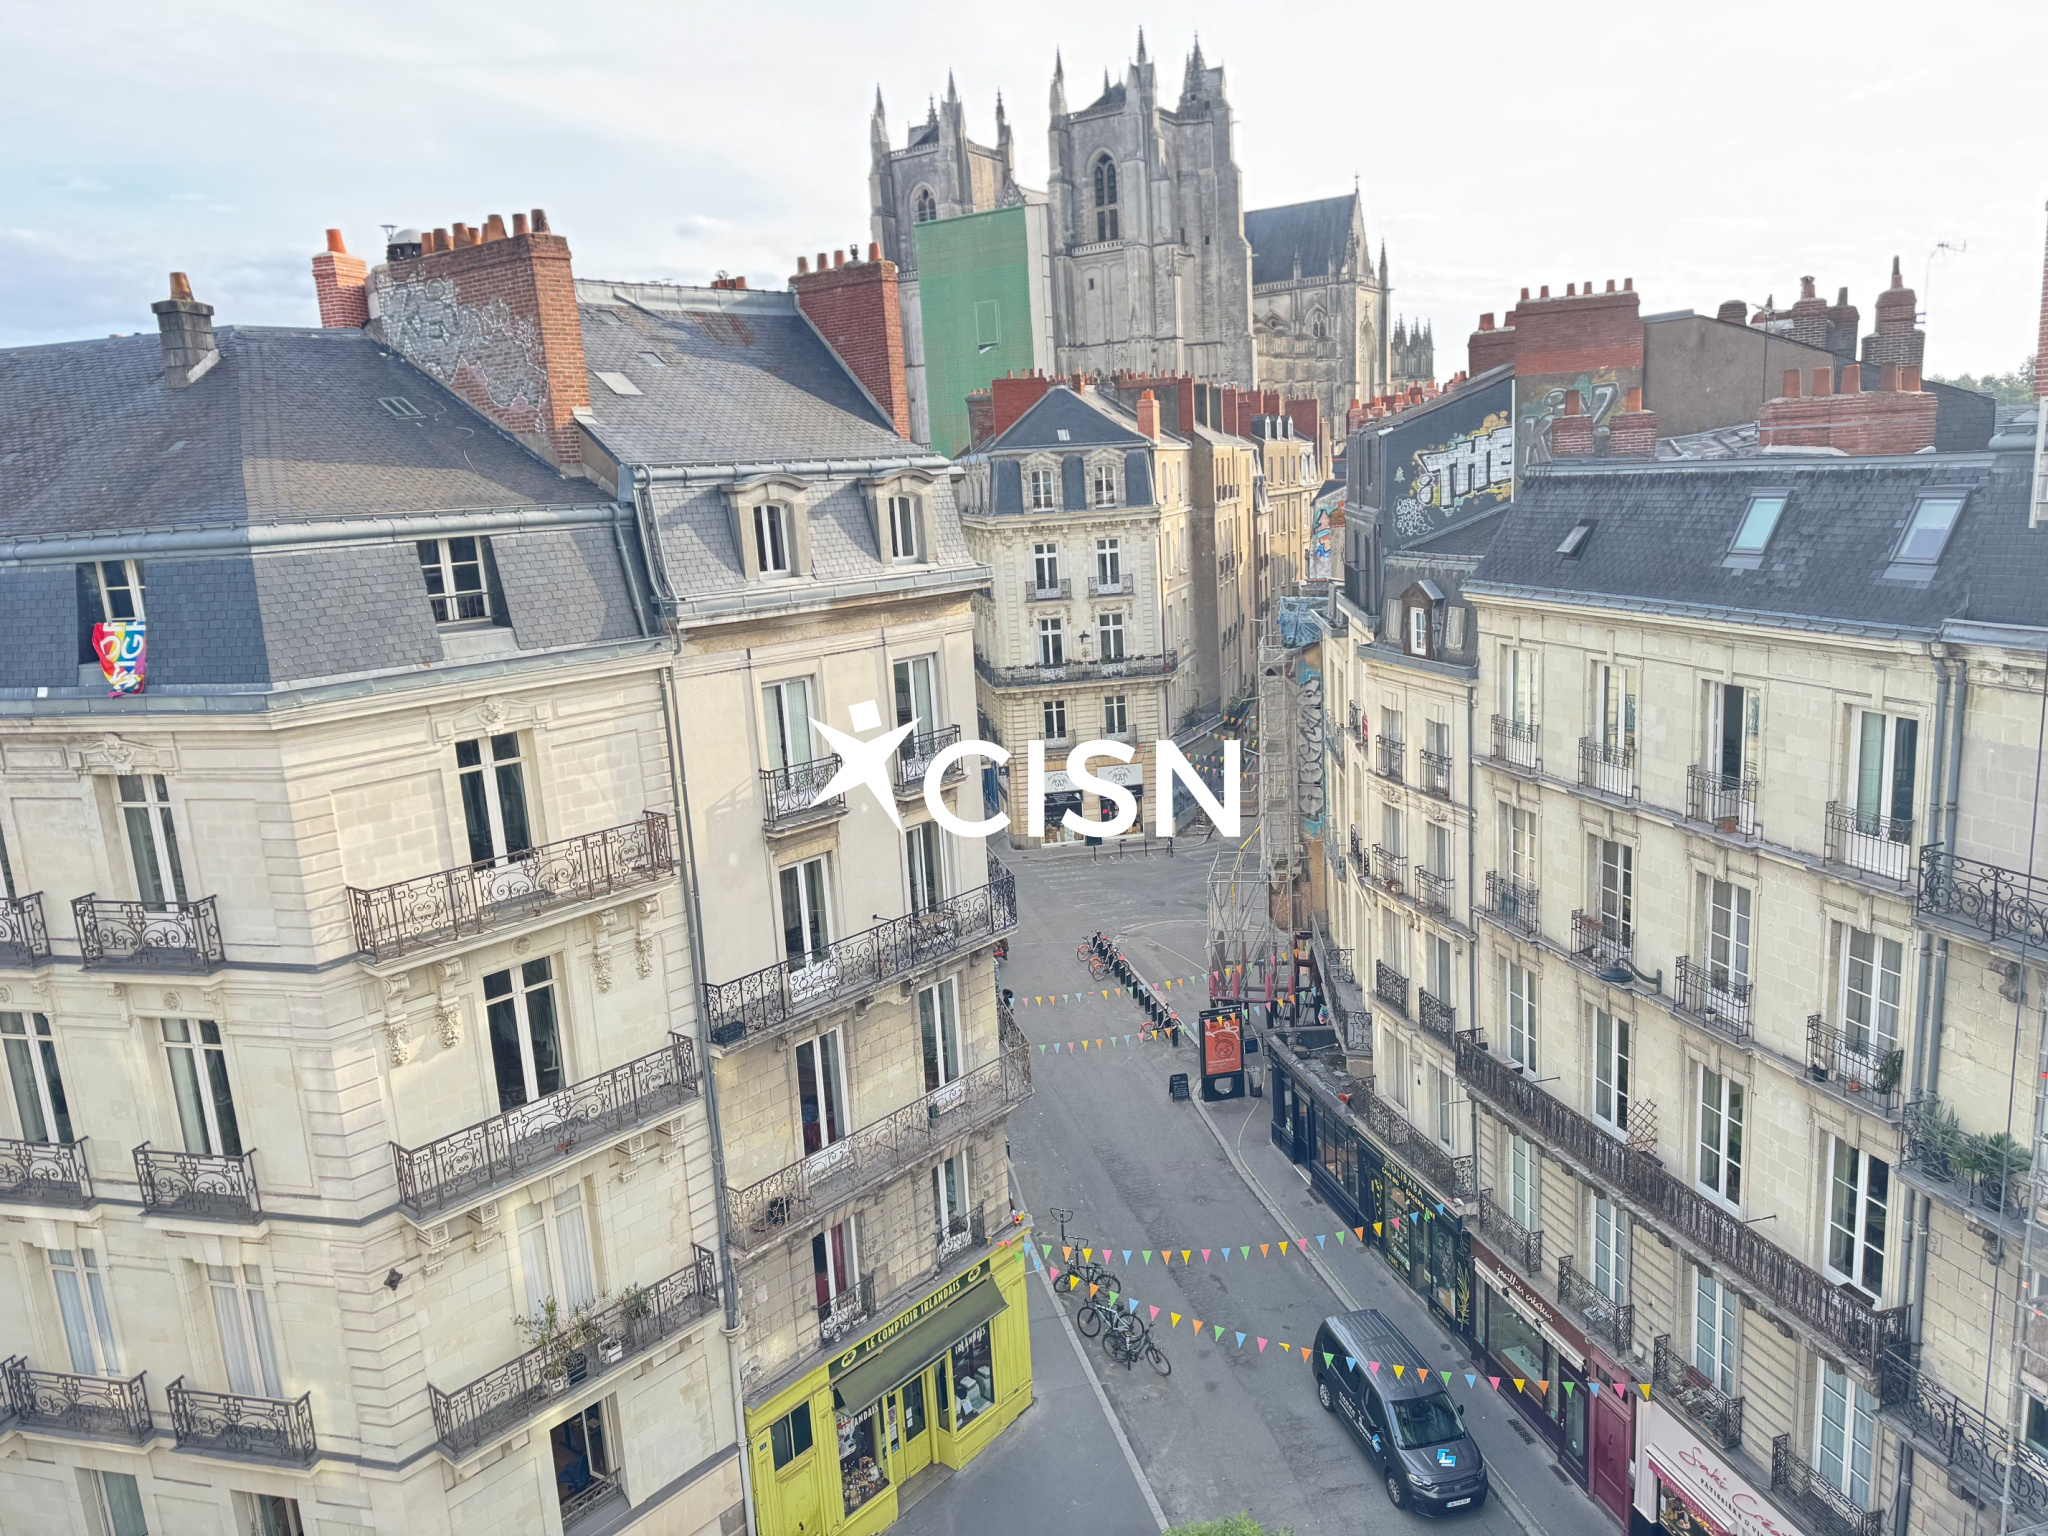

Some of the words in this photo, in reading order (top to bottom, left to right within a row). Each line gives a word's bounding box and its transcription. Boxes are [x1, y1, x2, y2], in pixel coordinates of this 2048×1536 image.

[865, 1336, 876, 1352] LE
[877, 1308, 918, 1343] COMPTOIR
[920, 1280, 961, 1315] IRLANDAIS
[1678, 1446, 1728, 1491] Saki
